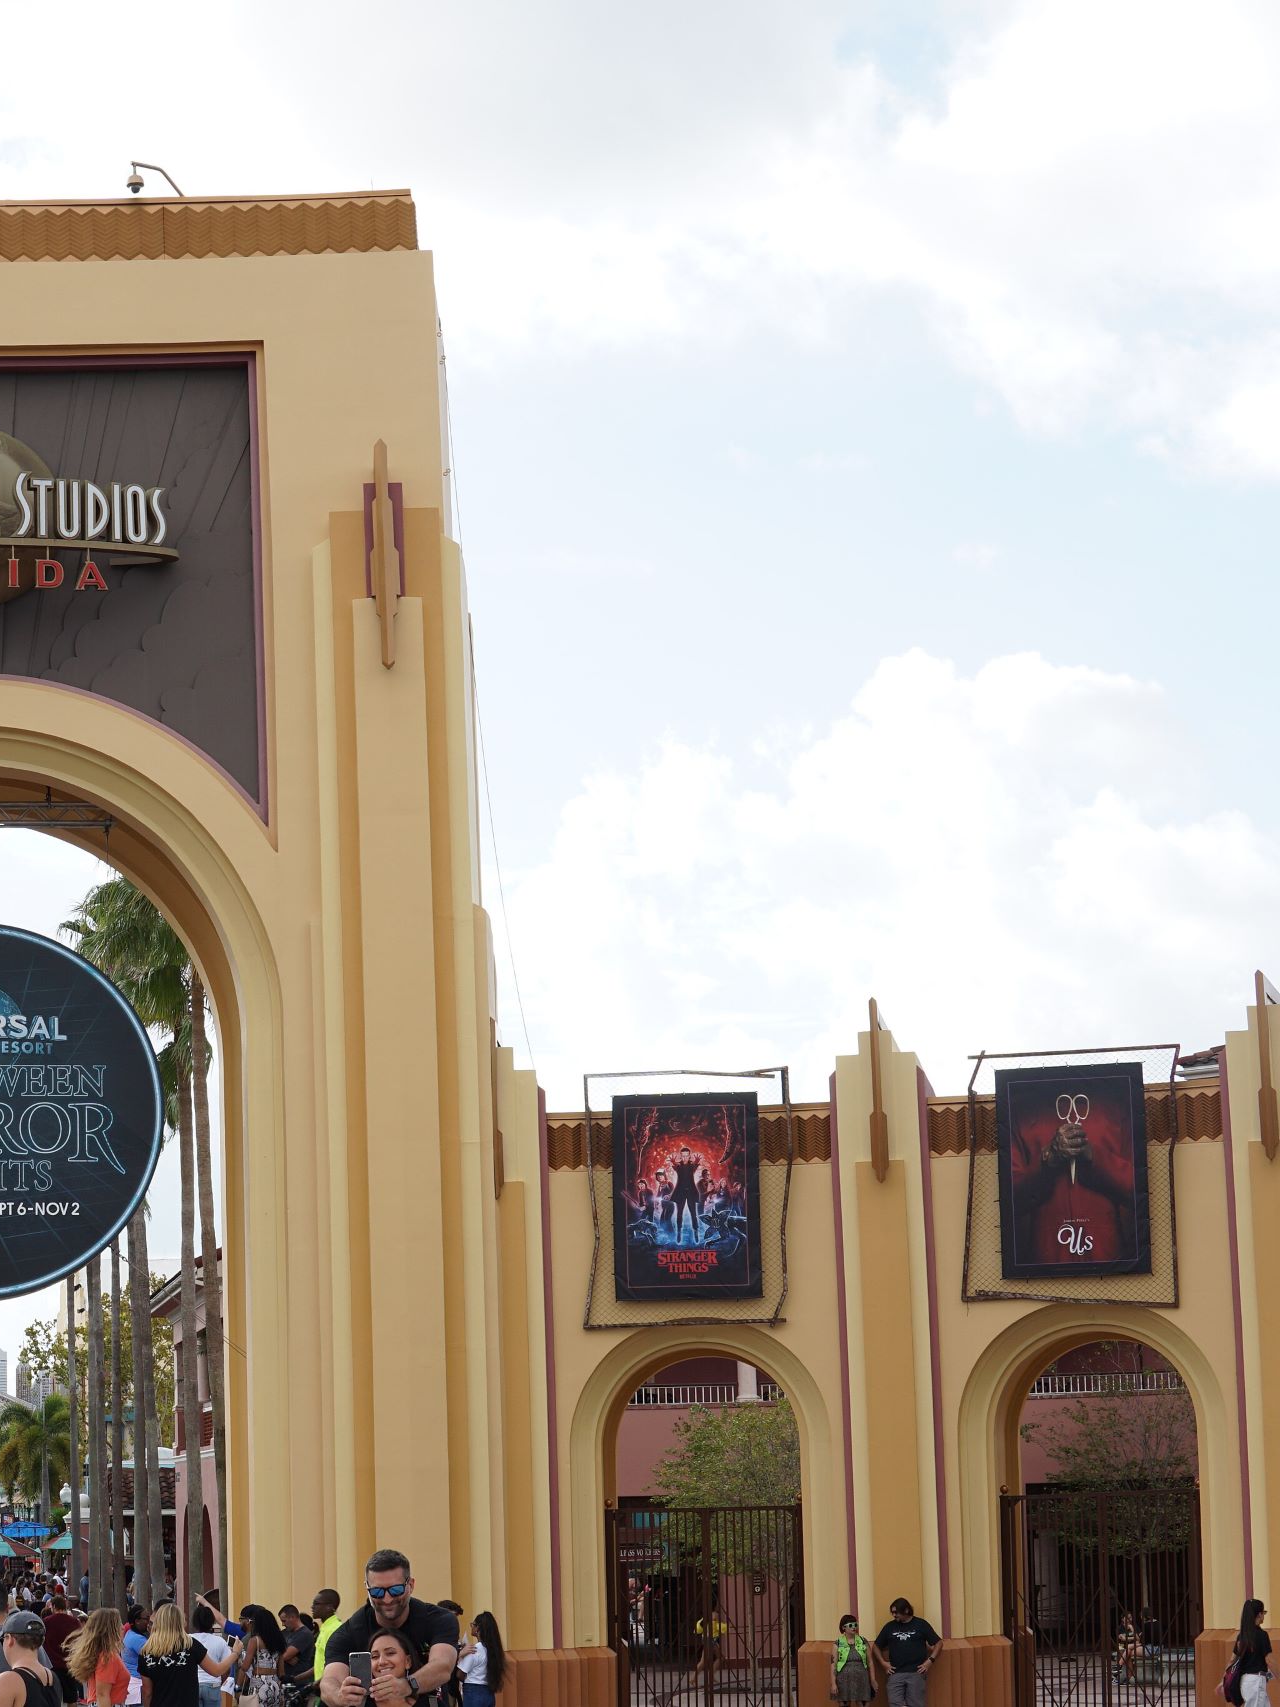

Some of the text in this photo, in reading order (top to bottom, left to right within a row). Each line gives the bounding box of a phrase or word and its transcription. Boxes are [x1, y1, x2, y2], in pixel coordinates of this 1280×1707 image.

[15, 472, 167, 545] STUDIOS
[71, 1201, 80, 1216] 2
[1057, 1223, 1094, 1256] Us
[656, 1250, 718, 1265] STRANGER
[668, 1262, 709, 1273] THINGS
